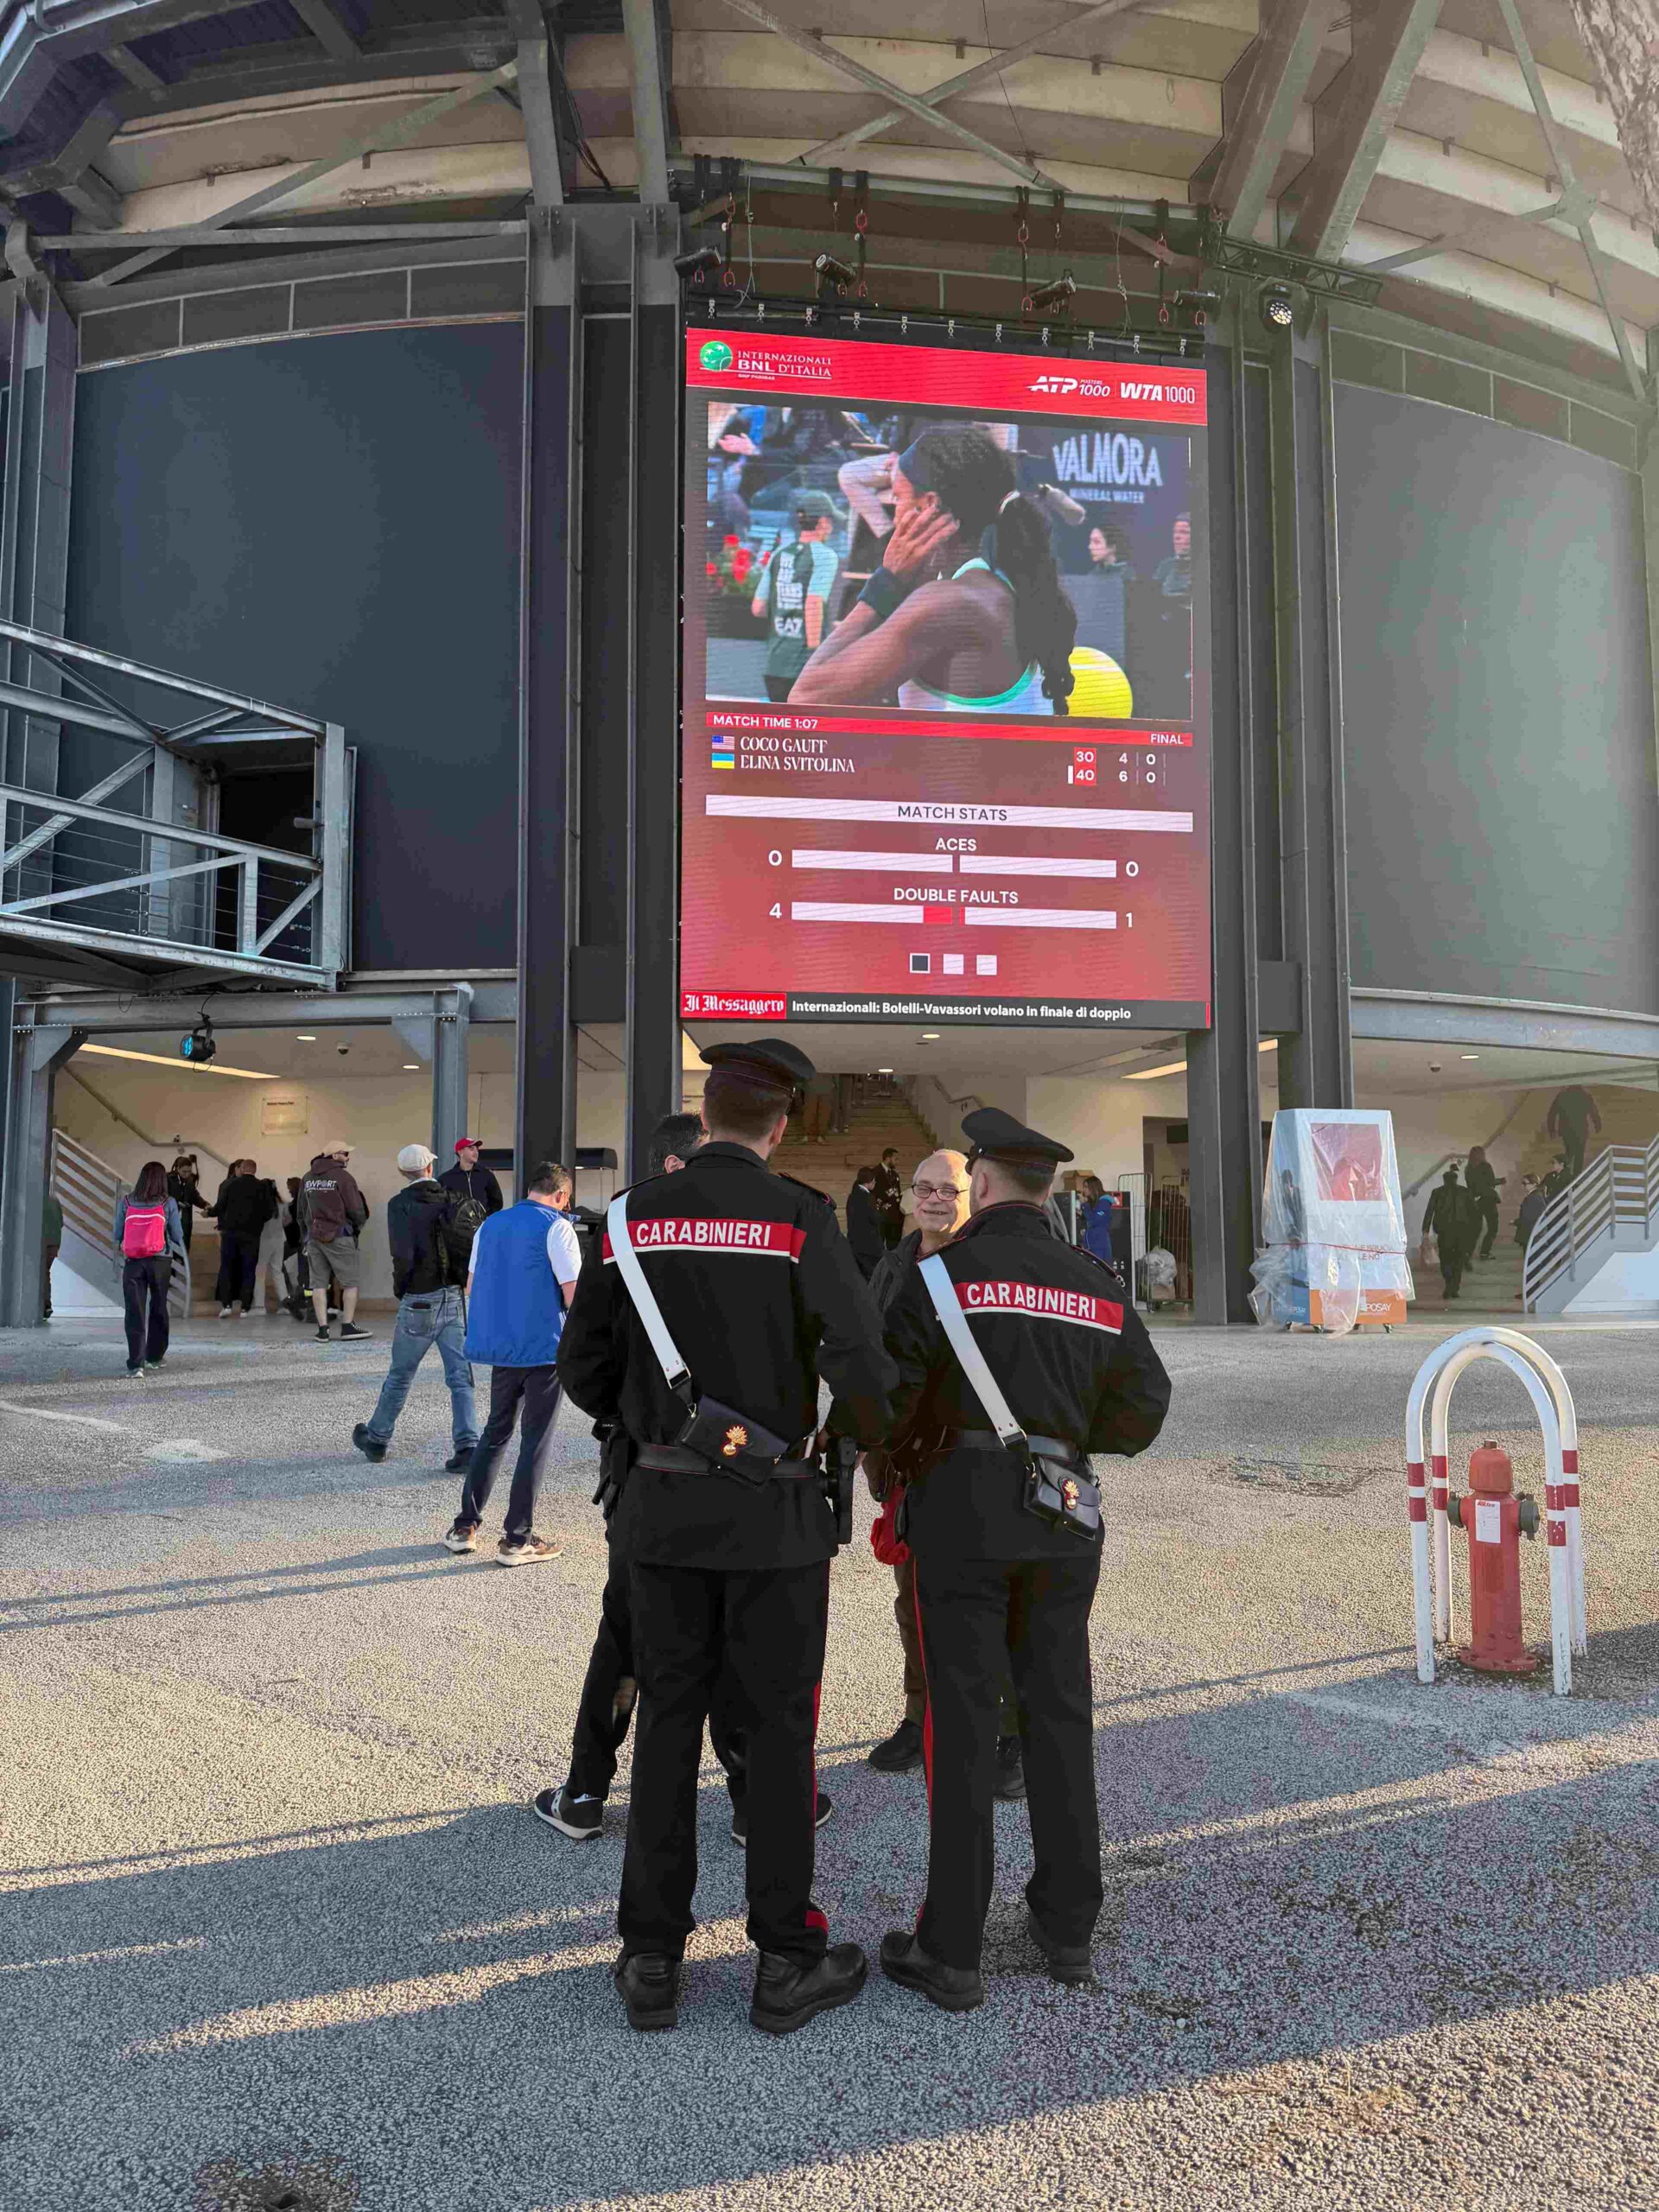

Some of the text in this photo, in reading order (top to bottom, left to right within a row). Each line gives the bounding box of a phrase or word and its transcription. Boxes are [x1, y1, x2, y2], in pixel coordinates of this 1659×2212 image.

[737, 350, 832, 366] INTERNAZIONALI
[738, 359, 832, 378] BNL D'ITALIA
[1026, 375, 1078, 395] ATP
[1078, 384, 1111, 397] 1000
[1120, 382, 1196, 404] WTA 1000
[1052, 432, 1163, 486] VALMORA
[774, 614, 804, 638] EA7
[713, 715, 818, 729] MATCH TIME 1:07
[740, 736, 828, 754] COCO GAUFF
[1150, 733, 1185, 745] FINAL
[740, 753, 855, 772] ELINA SVITOLINA
[1076, 751, 1156, 766] 30 4 0
[1076, 769, 1156, 784] 40 6 0
[898, 805, 1007, 822] MATCH STATS
[935, 837, 977, 852] ACES
[768, 850, 783, 866] 0
[1125, 861, 1139, 877] 0
[893, 888, 1019, 904] DOUBLE FAULTS
[769, 903, 783, 919] 4
[1125, 912, 1133, 928] 1
[684, 995, 785, 1014] Il Messaggero
[792, 1001, 1132, 1021] Internazionali: Bolelli-Vavassori volano in finale di doppio
[636, 1220, 772, 1248] CARABINIERI
[967, 1282, 1096, 1320] CARABINIERI
[1366, 1302, 1392, 1313] POSAY
